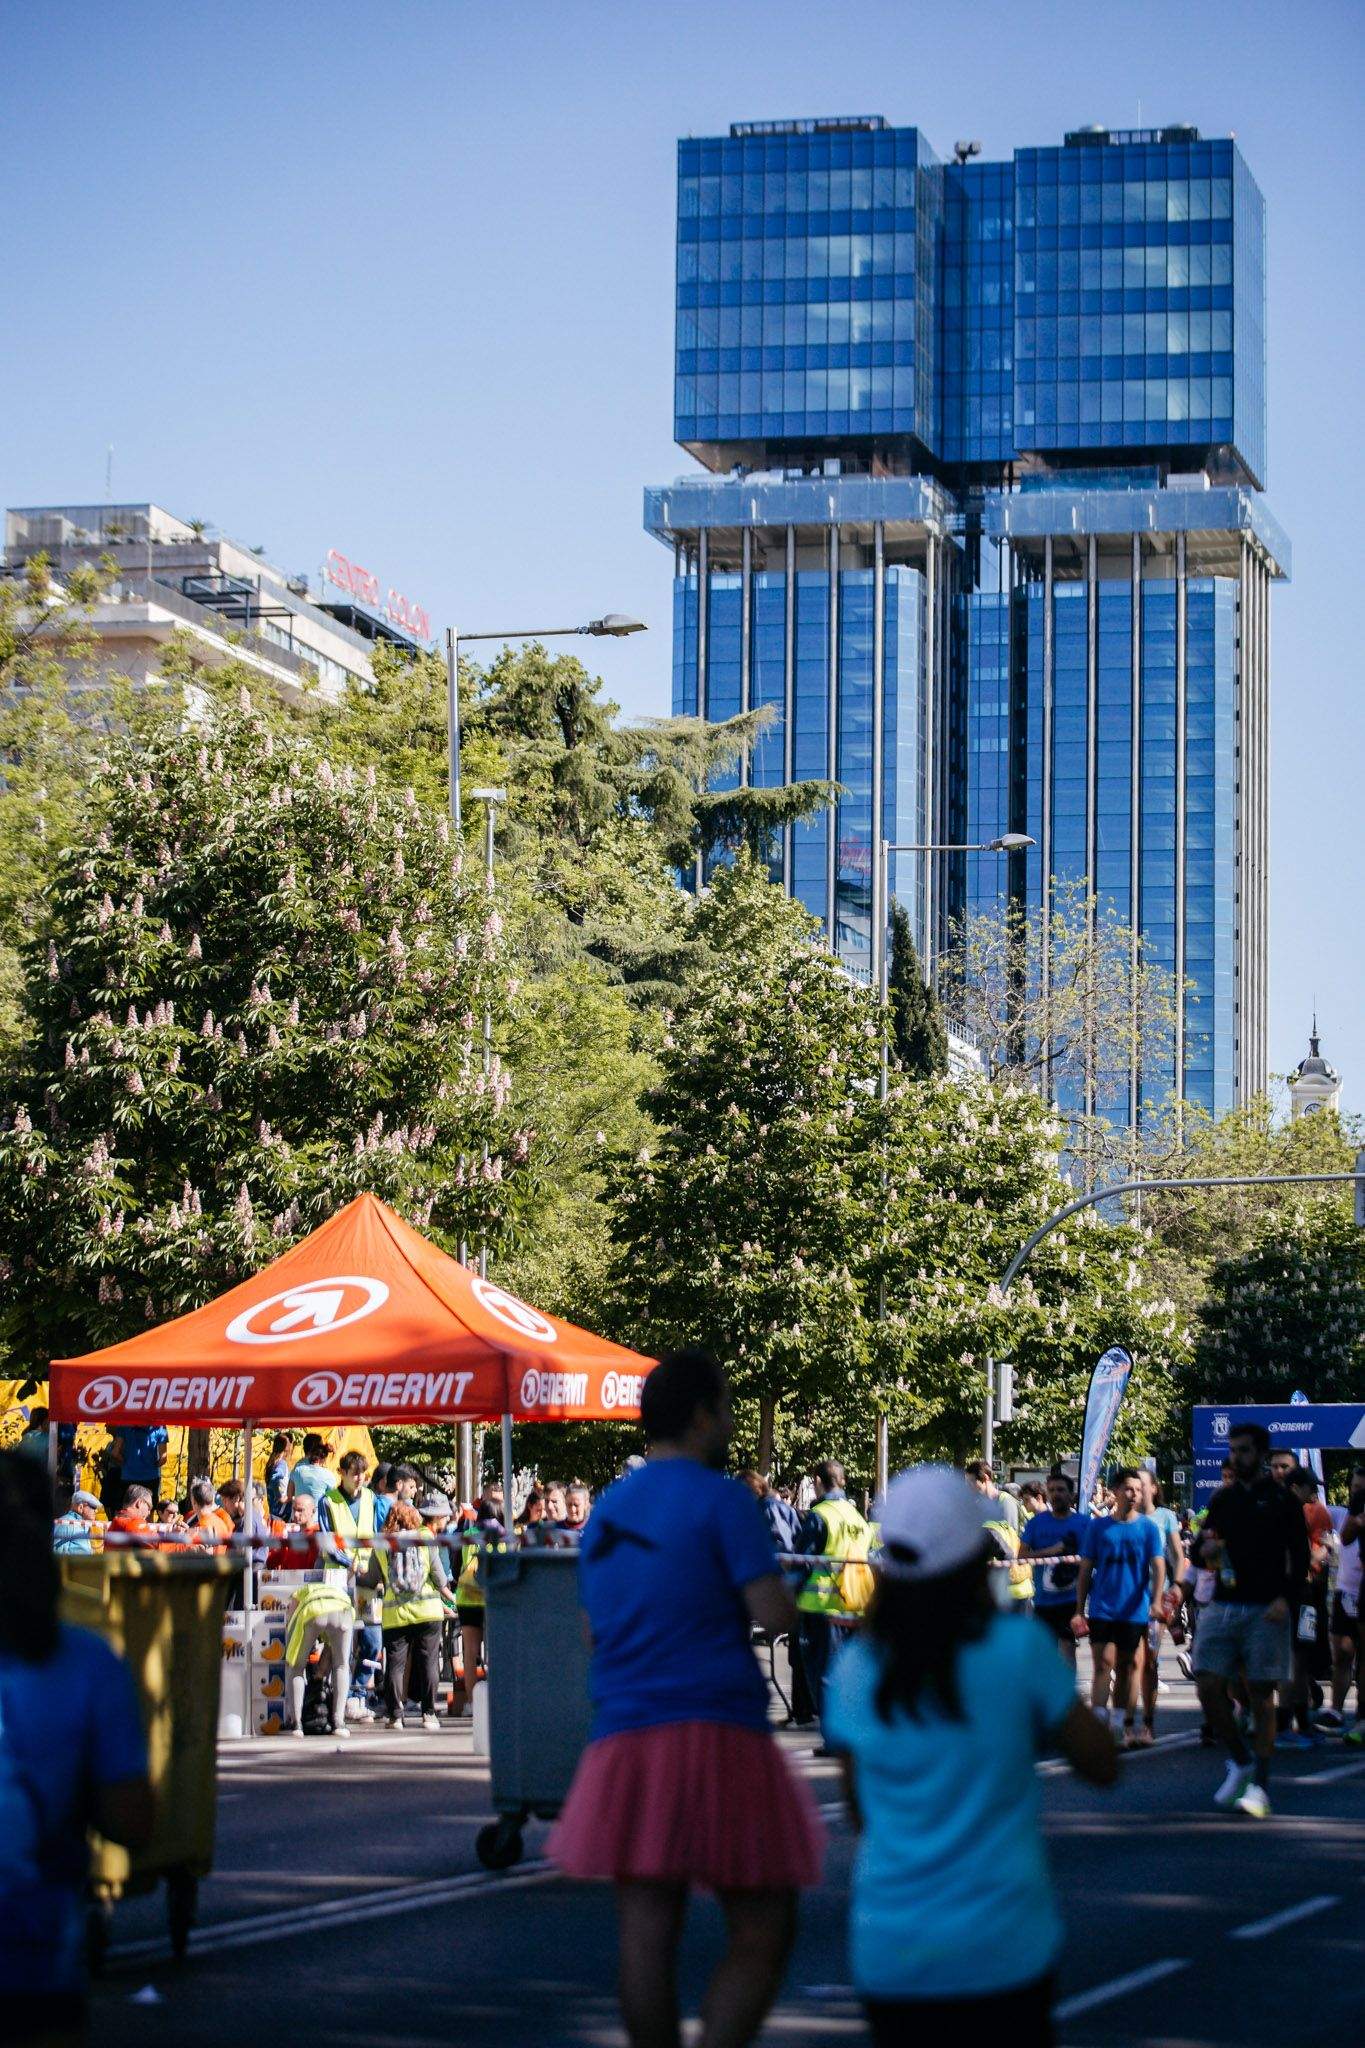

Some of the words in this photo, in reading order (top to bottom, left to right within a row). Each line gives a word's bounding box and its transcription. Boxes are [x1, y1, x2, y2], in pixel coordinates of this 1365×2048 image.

[125, 1376, 254, 1409] ENERVIT
[340, 1371, 473, 1407] ENERVIT
[539, 1372, 588, 1405] ENERVIT
[1280, 1422, 1314, 1432] ENERVIT
[1205, 1479, 1223, 1488] ENER
